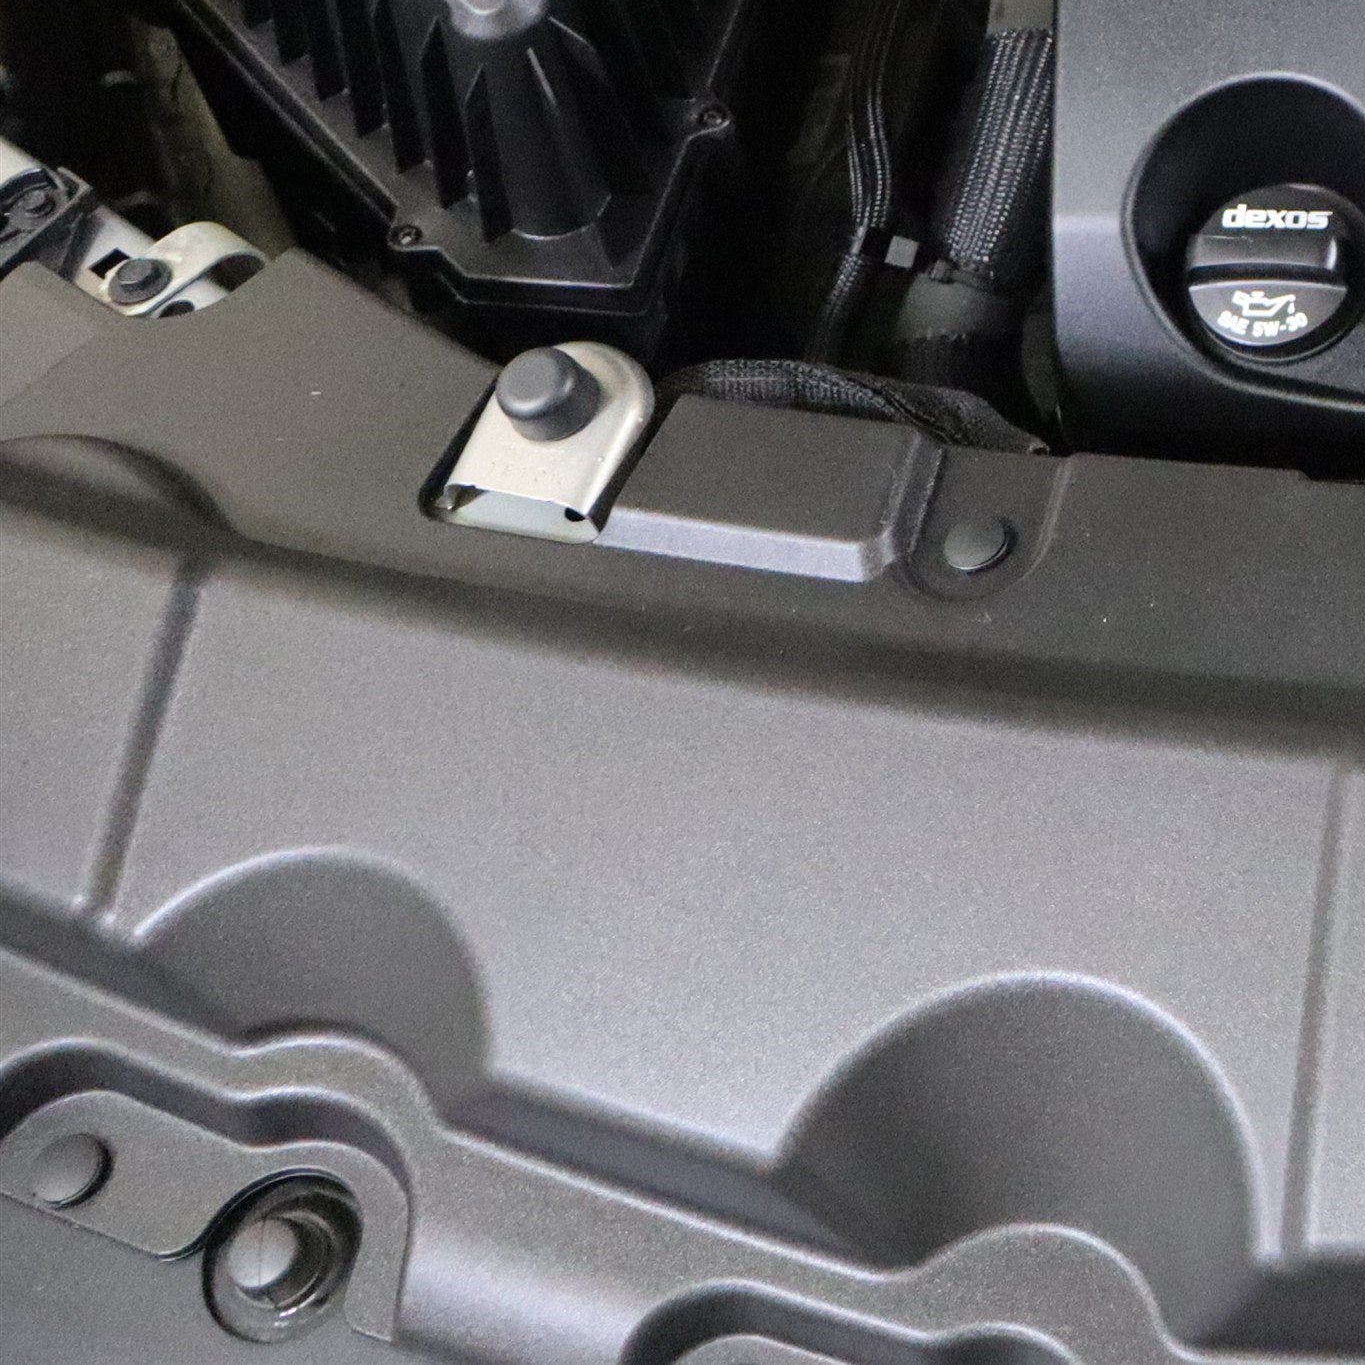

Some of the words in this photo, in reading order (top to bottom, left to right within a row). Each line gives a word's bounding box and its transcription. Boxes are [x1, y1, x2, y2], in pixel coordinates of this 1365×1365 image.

[1221, 203, 1334, 230] dexos
[1216, 310, 1250, 336] SAE
[1251, 311, 1309, 338] 5W-30
